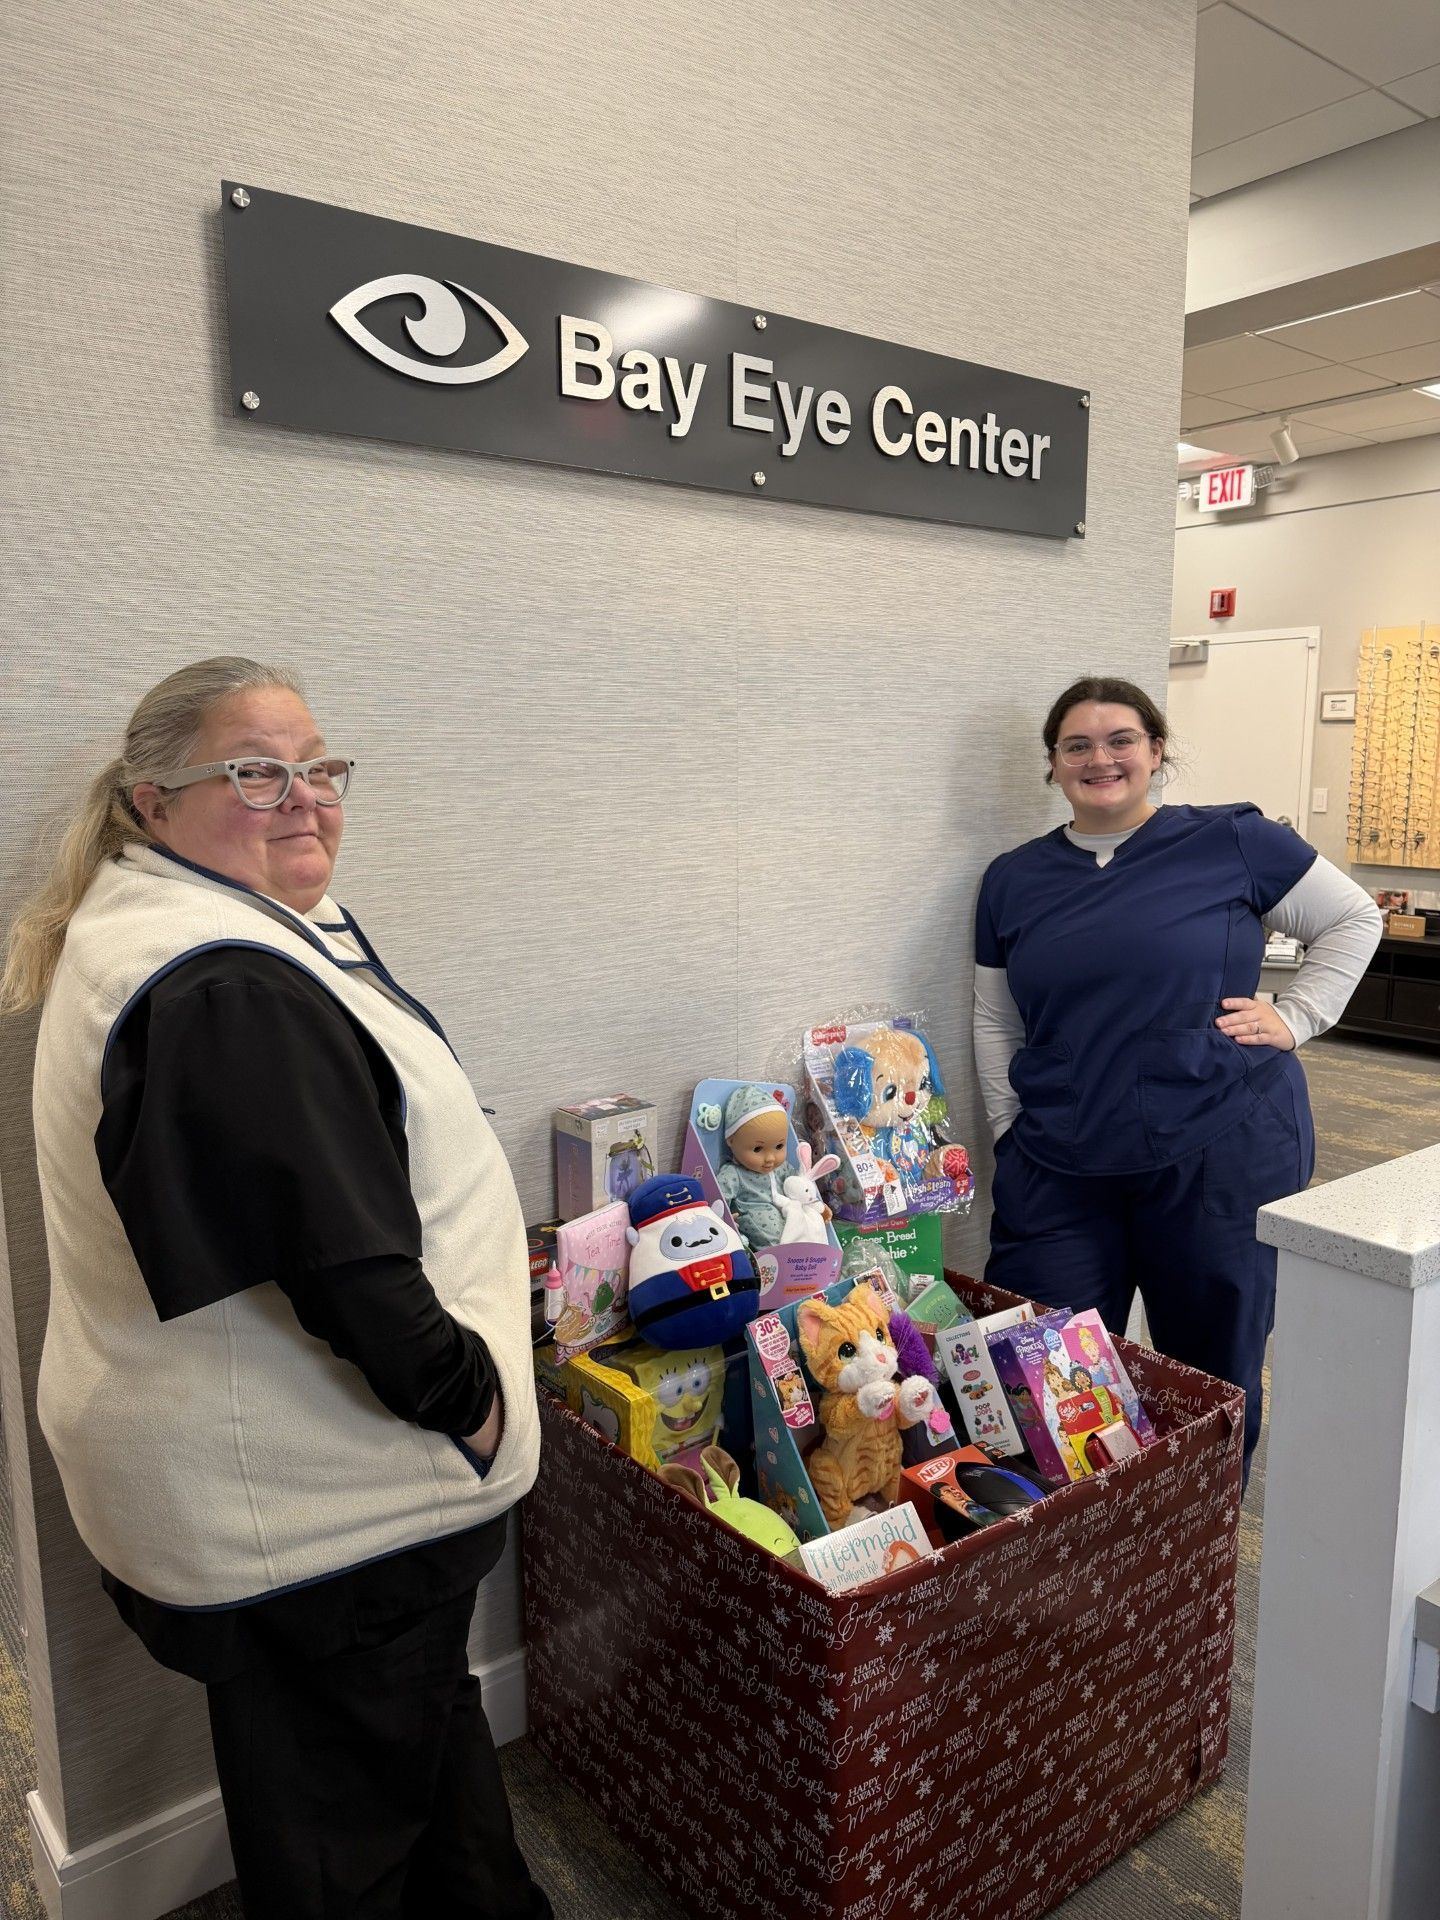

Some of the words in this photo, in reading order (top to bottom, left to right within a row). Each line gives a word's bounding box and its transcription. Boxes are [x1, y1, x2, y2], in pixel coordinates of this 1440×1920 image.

[559, 314, 707, 437] Bay
[732, 352, 852, 457] Eye
[872, 385, 1051, 481] Center
[1208, 469, 1246, 505] EXIT
[856, 1162, 874, 1173] 80+
[887, 1229, 917, 1244] Bread
[586, 1246, 600, 1259] Tea
[531, 1258, 548, 1269] LEGO
[757, 1318, 779, 1337] 30+
[946, 1331, 970, 1342] COLLECTIONS
[1018, 1336, 1036, 1345] Disney
[919, 1460, 950, 1480] NERF
[809, 1508, 917, 1579] Mermaid
[1001, 1536, 1026, 1552] HAPPY
[910, 1576, 938, 1593] HAPPY
[1041, 1572, 1065, 1588] HAPPY
[956, 1613, 982, 1630] HAPPY
[1076, 1607, 1098, 1622] HAPPY
[1109, 1639, 1130, 1654] HAPPY
[856, 1655, 885, 1673] HAPPY
[995, 1648, 1019, 1664] HAPPY
[1031, 1680, 1054, 1696] HAPPY
[903, 1691, 930, 1709] HAPPY
[947, 1725, 972, 1743] HAPPY
[988, 1757, 1012, 1774] HAPPY
[848, 1776, 880, 1798] HAPPY
[899, 1807, 926, 1827] HAPPY
[941, 1837, 966, 1855] HAPPY
[844, 1893, 876, 1916] HAPPY
